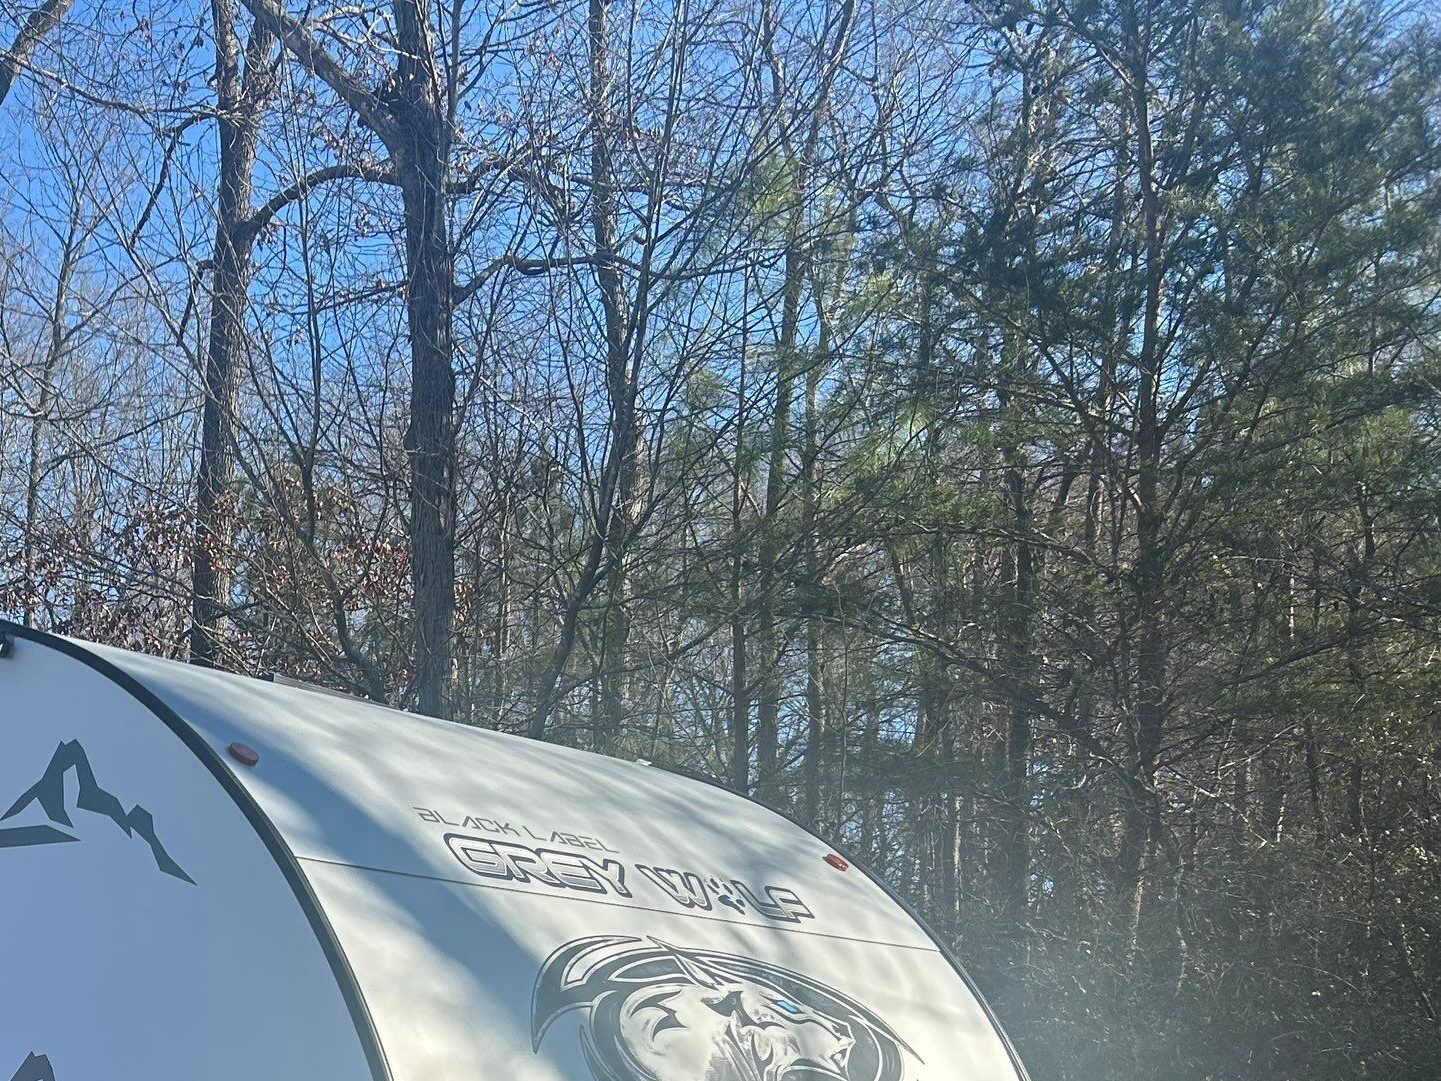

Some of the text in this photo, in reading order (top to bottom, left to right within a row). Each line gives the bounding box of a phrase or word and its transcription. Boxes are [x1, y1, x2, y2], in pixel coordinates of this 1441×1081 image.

[412, 806, 620, 854] BLACK LABEL
[443, 832, 633, 899] GREY
